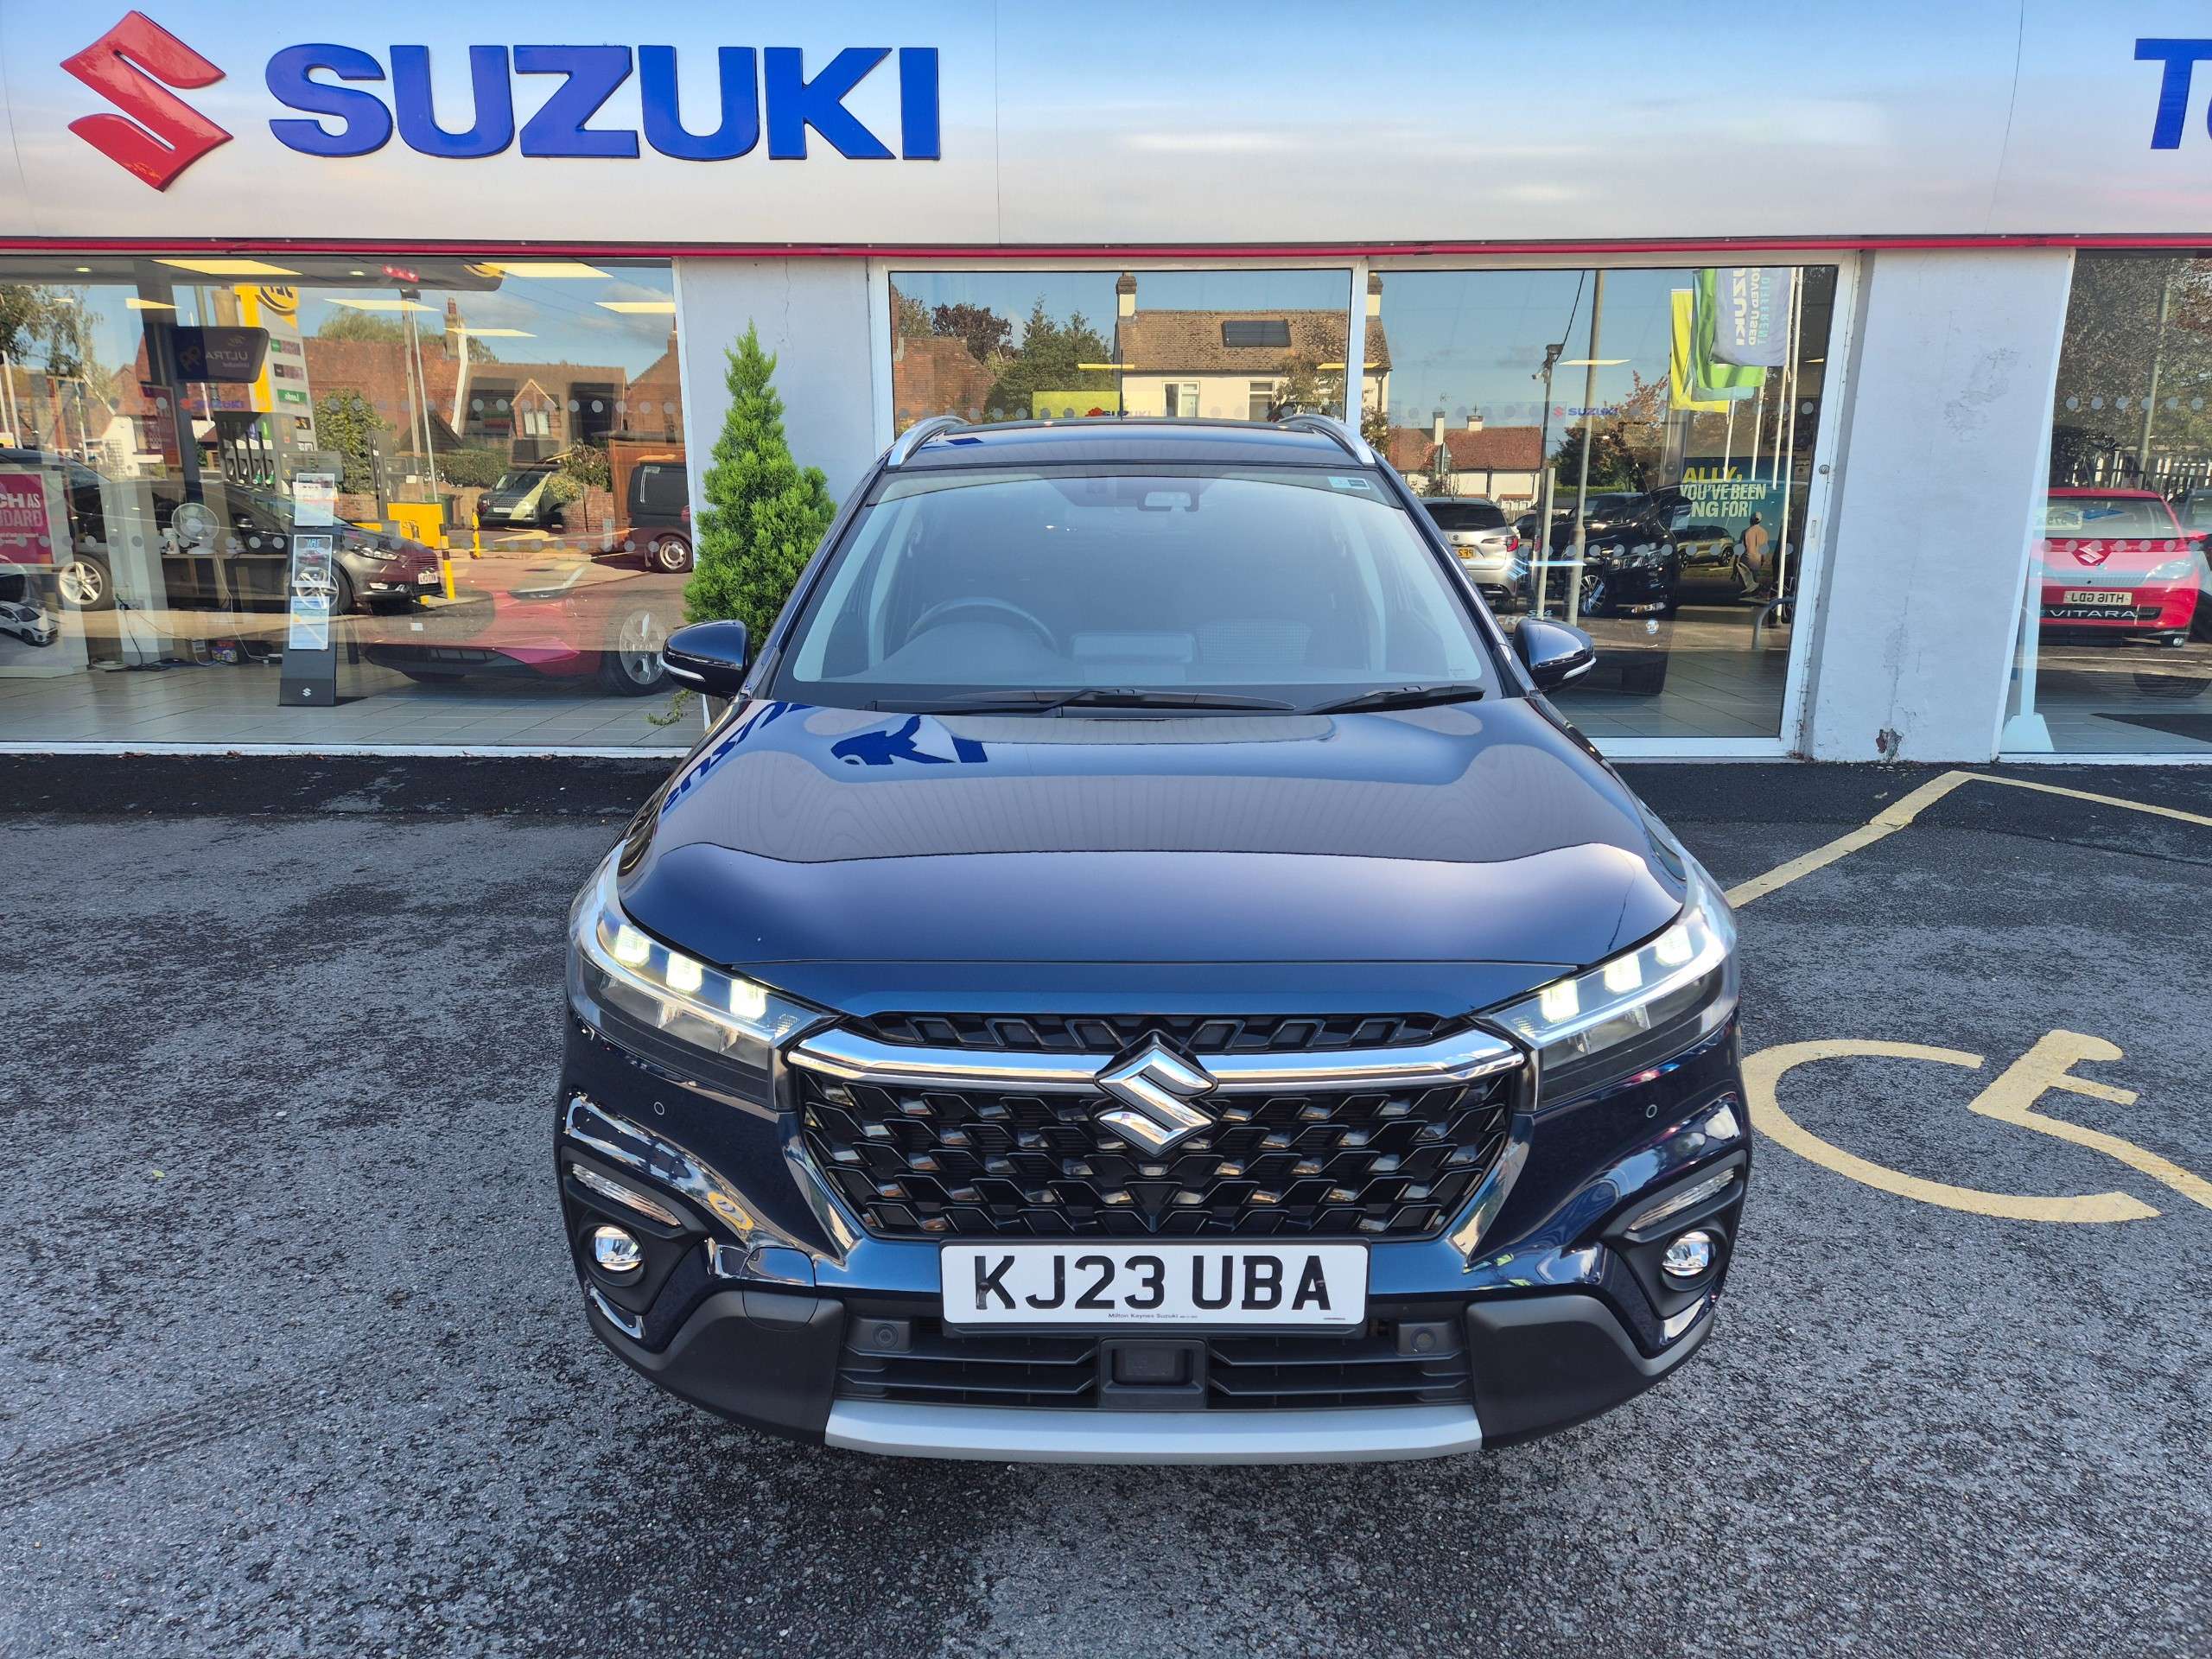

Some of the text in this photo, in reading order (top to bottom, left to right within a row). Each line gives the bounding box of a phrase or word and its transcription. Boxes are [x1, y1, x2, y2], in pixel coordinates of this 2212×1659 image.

[265, 43, 941, 162] SUZUKI
[2134, 38, 2212, 150] T
[1568, 407, 1618, 416] SUZUKI
[27, 493, 41, 508] AS
[1679, 483, 1767, 500] YOU'VE BEEN
[0, 509, 43, 527] DARD
[1690, 500, 1719, 518] NG
[2050, 609, 2137, 618] VITARA
[975, 1255, 1332, 1311] KJ23 UBA
